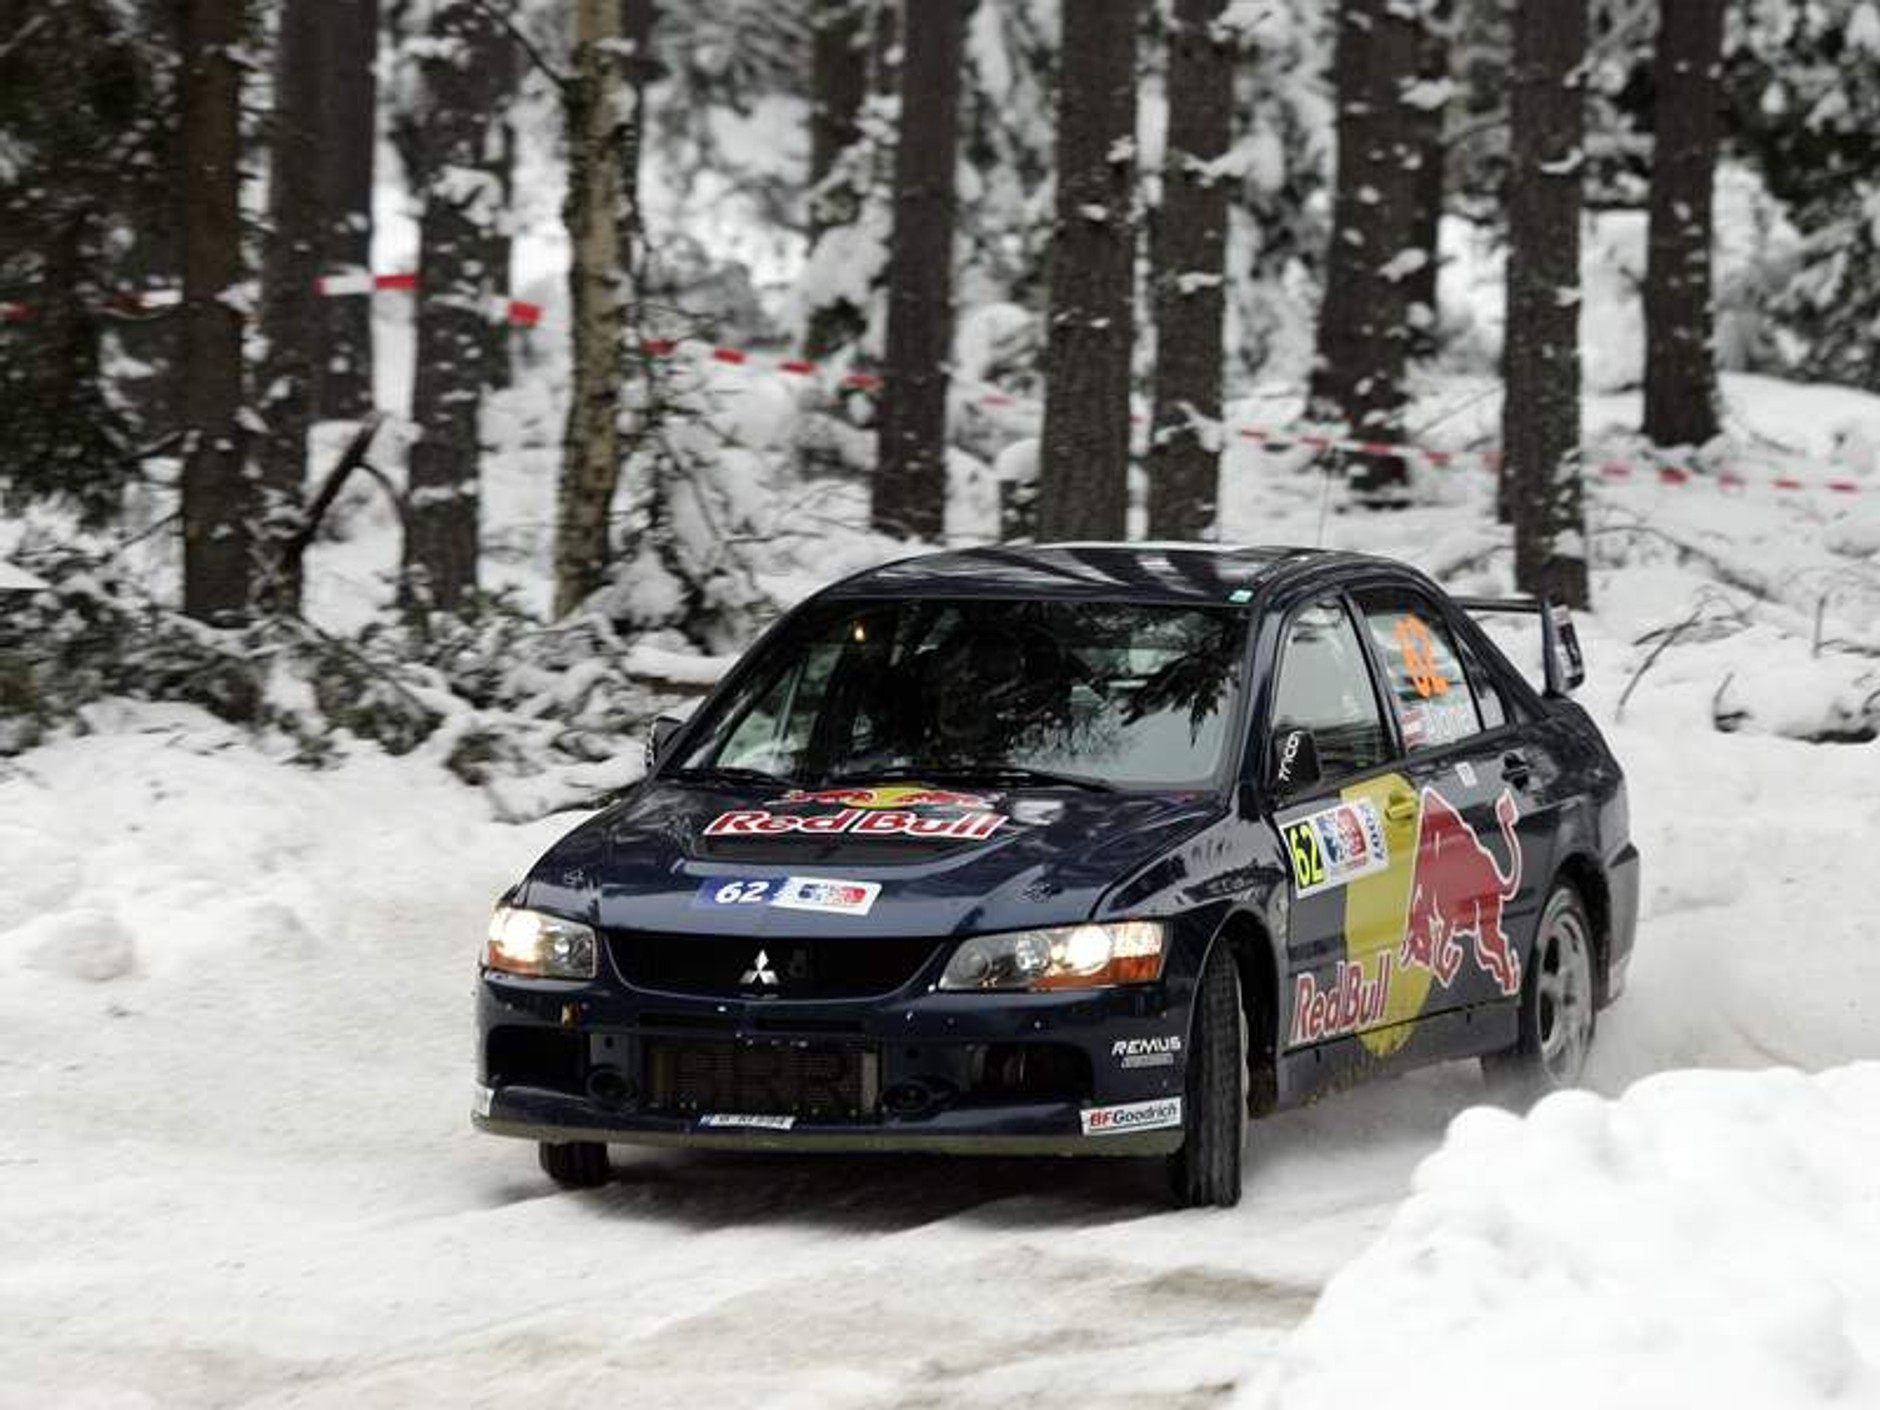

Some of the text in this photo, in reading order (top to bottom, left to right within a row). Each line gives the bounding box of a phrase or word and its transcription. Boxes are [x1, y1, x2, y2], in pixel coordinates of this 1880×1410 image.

[1289, 824, 1324, 887] 62
[714, 881, 770, 904] 62
[1111, 1036, 1181, 1056] REMUS
[1090, 1102, 1177, 1127] BFGoodrich
